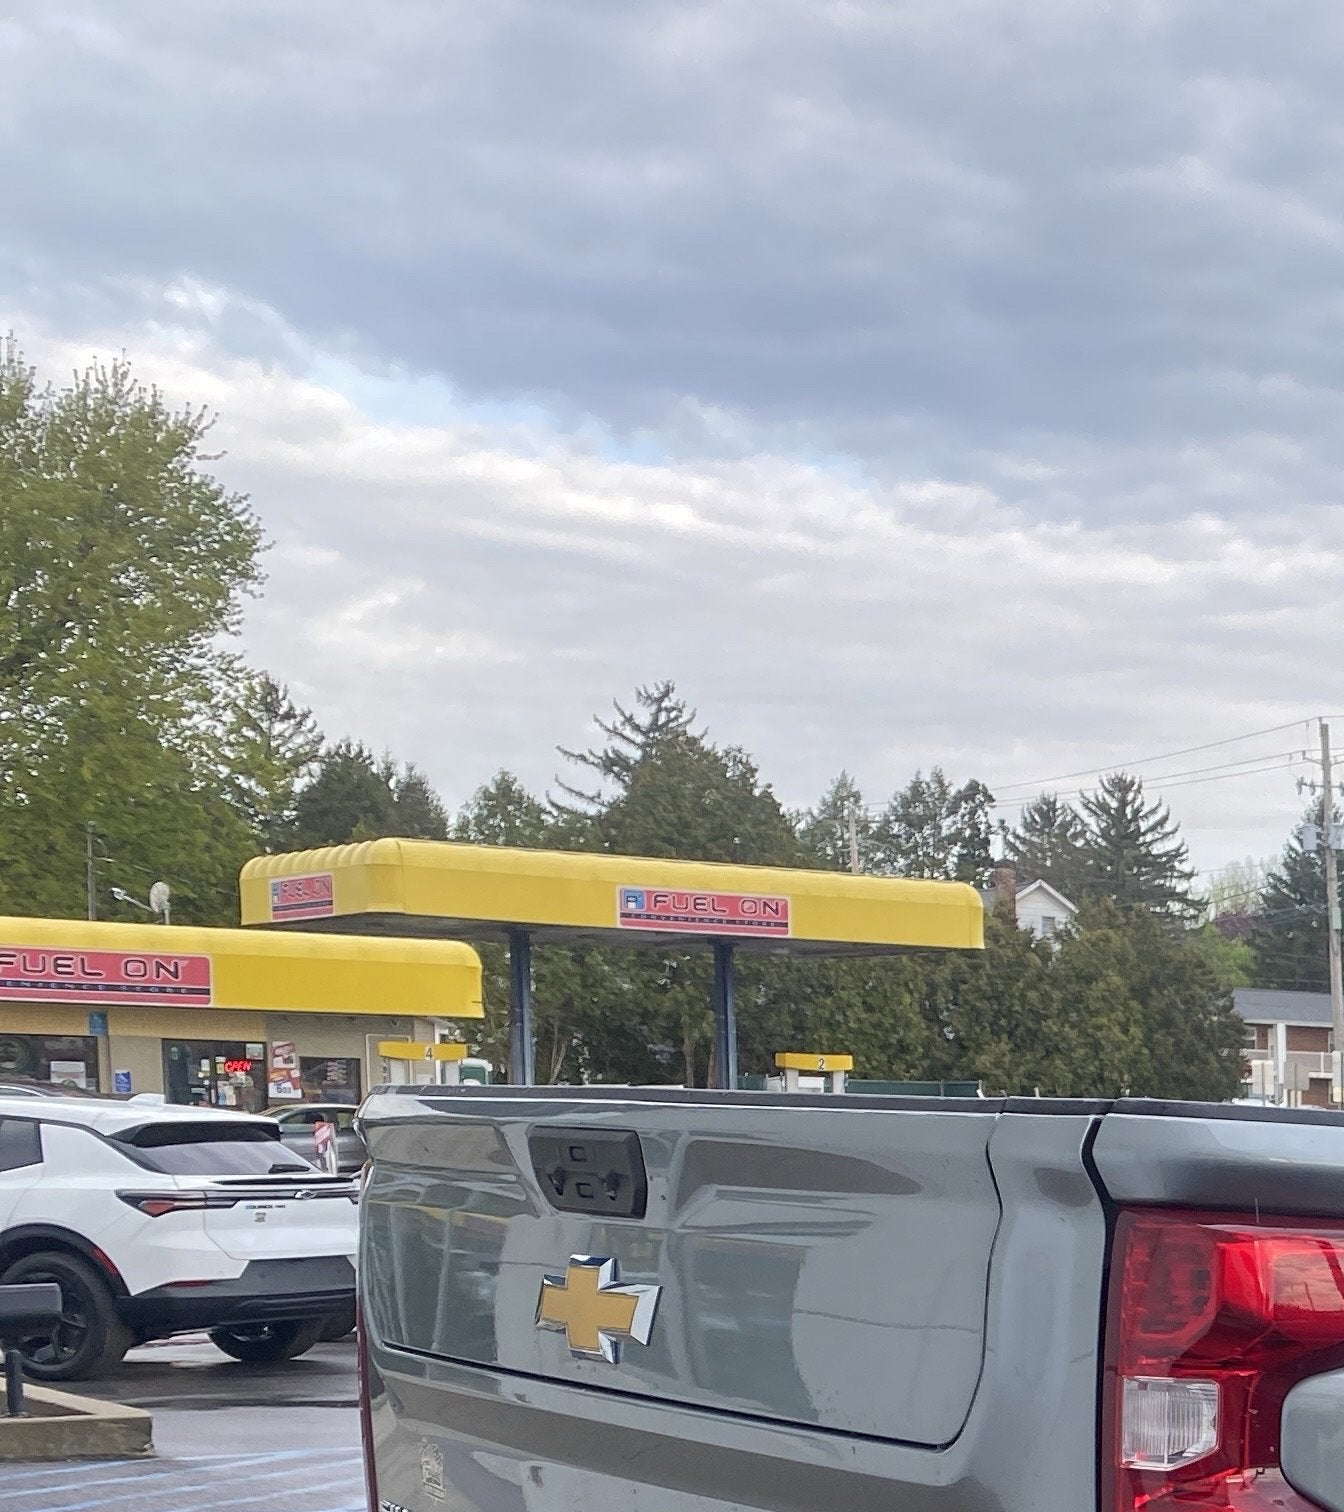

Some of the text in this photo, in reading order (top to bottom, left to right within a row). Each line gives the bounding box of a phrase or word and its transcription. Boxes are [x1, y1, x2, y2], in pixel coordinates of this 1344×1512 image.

[653, 893, 780, 916] FUEL ON
[124, 958, 181, 980] ON
[818, 1058, 825, 1071] 2
